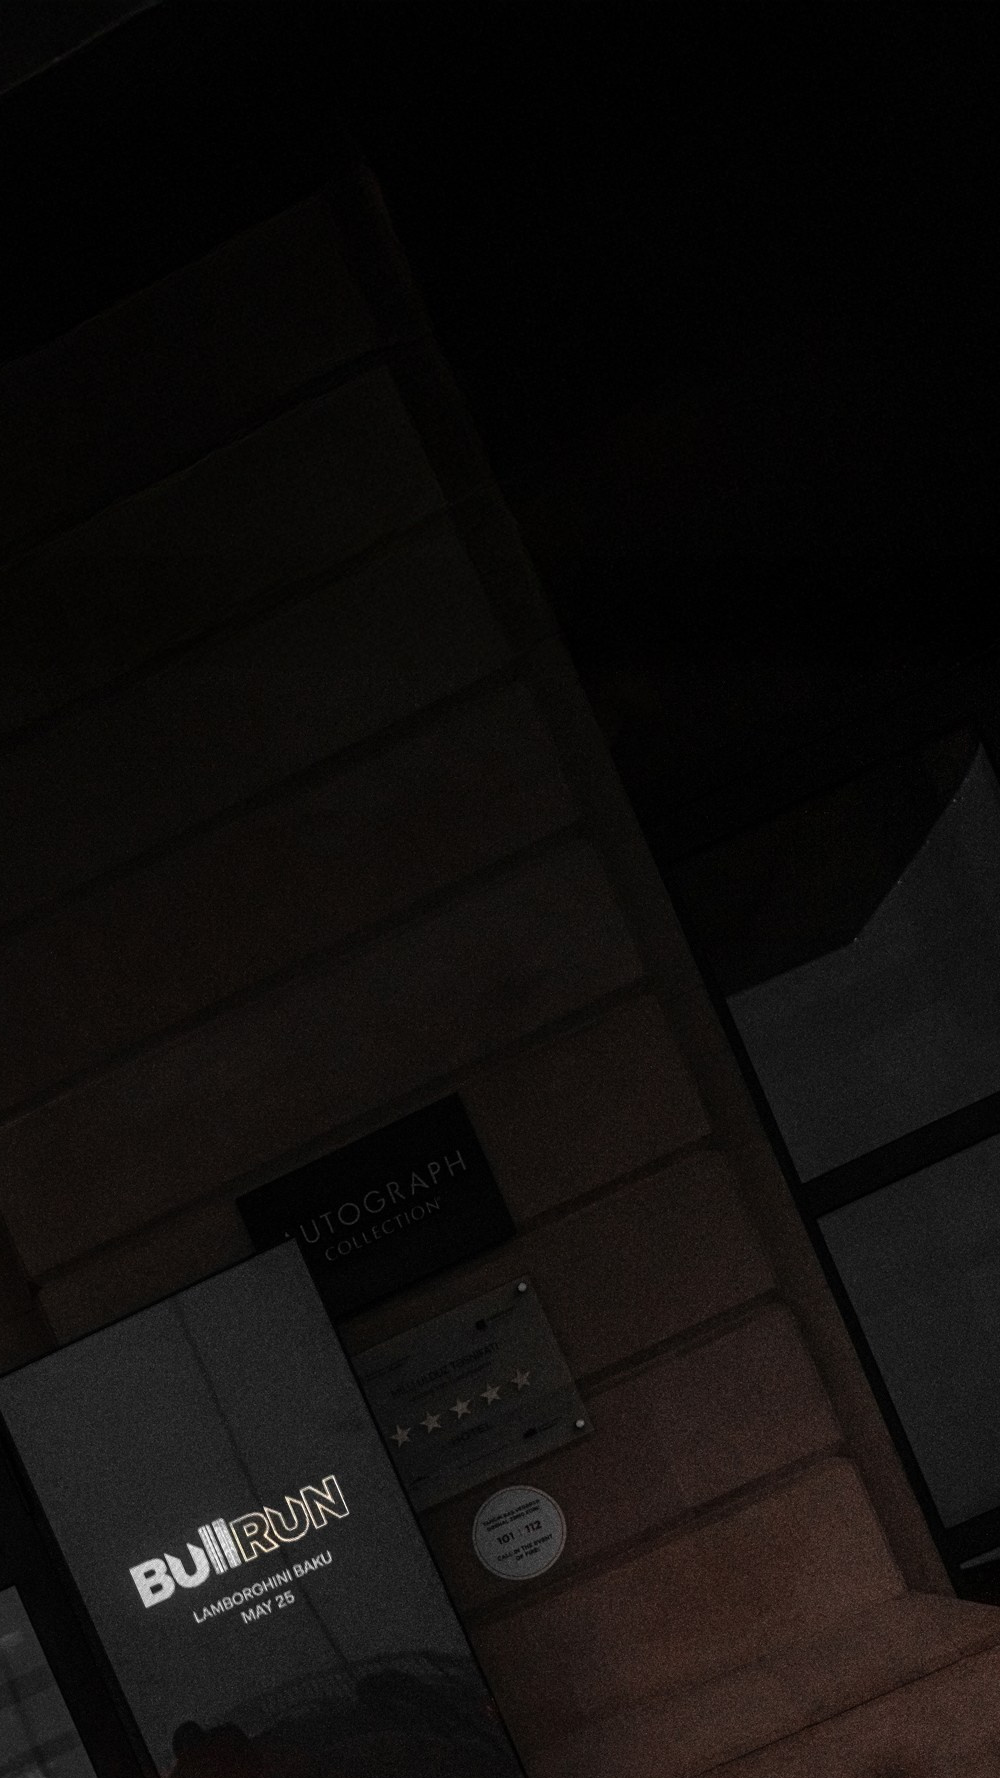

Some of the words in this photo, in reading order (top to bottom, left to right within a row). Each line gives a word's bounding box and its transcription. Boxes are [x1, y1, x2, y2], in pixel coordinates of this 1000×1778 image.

[284, 1150, 467, 1244] UTOGRAPH
[325, 1197, 441, 1261] COLLECTION
[497, 1532, 515, 1545] 101
[525, 1520, 542, 1533] 112
[193, 1569, 293, 1624] LAMBORGHINI
[294, 1550, 333, 1579] BAKU
[240, 1600, 273, 1624] MAY
[275, 1590, 296, 1611] 25
